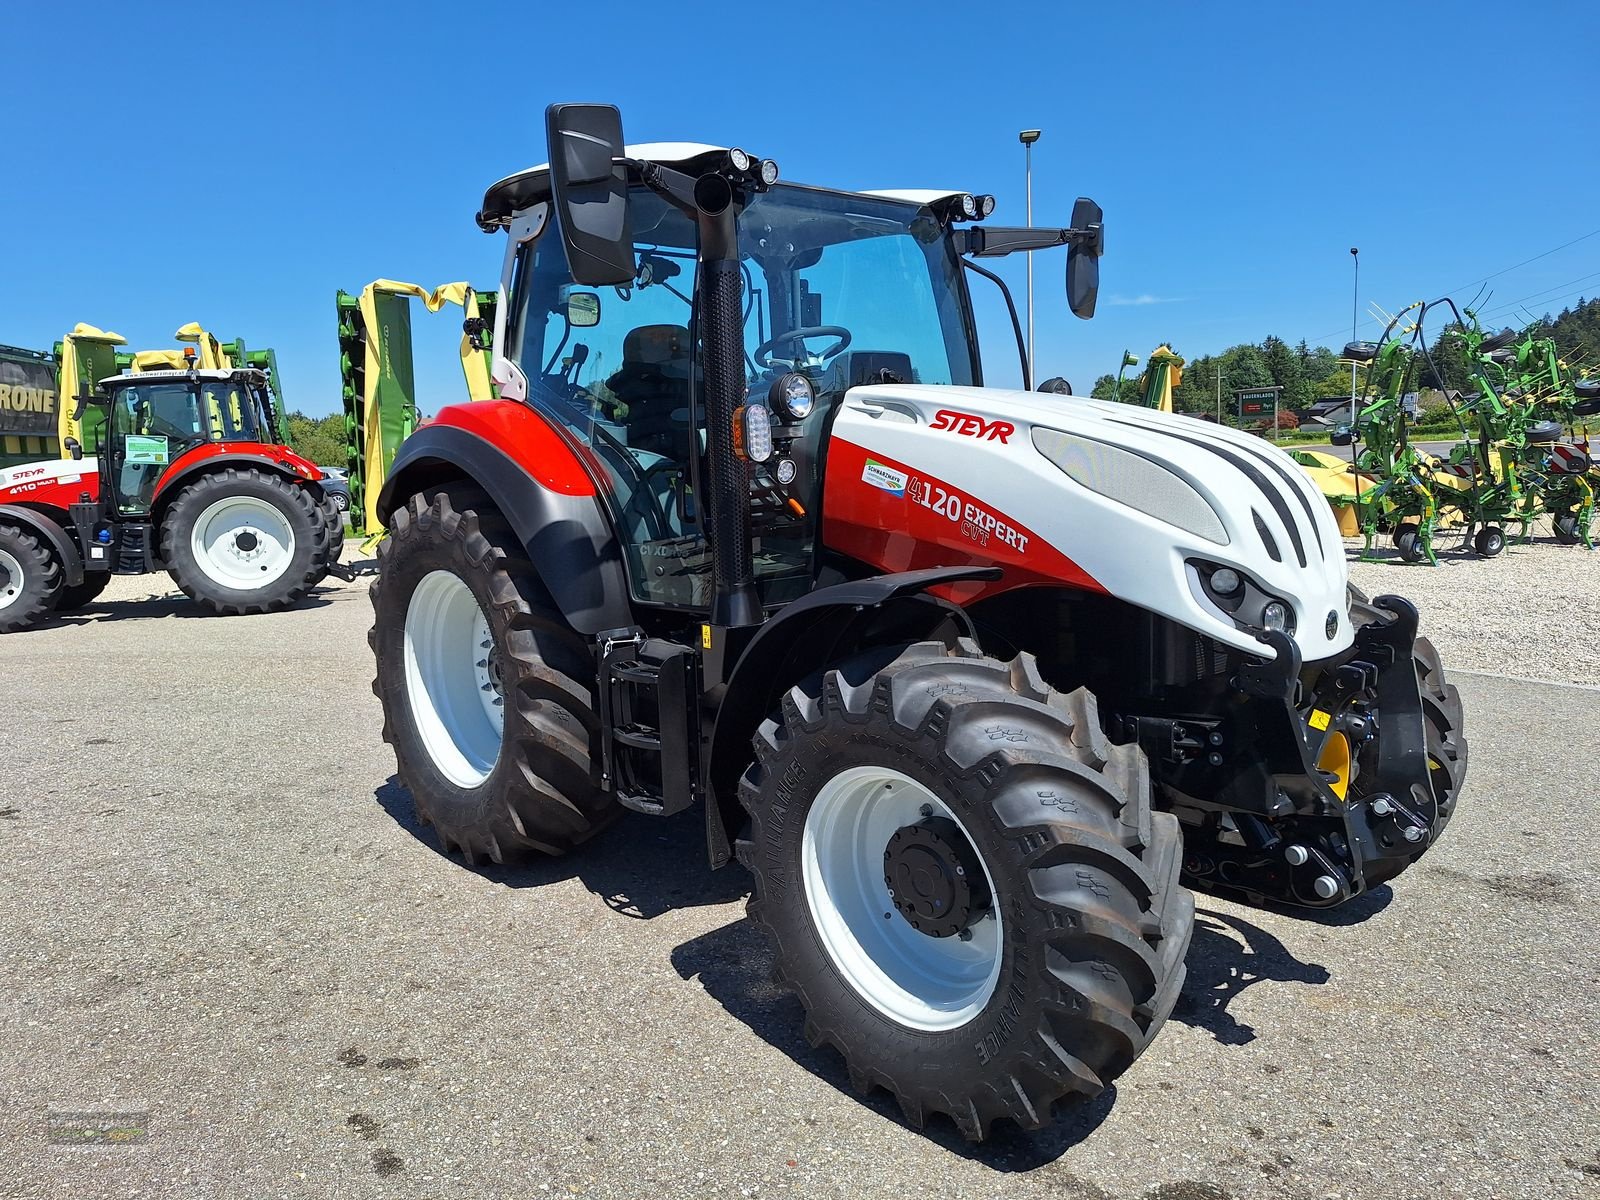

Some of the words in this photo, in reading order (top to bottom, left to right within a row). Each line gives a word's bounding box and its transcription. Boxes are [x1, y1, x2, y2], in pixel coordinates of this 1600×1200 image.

[929, 409, 1015, 444] STEYR
[12, 467, 45, 480] STEYR
[867, 465, 901, 483] SCHWARZMAYR
[9, 483, 37, 495] 4110
[36, 479, 56, 487] MULTI
[906, 476, 962, 523] 4120
[963, 503, 1029, 554] EXPERT
[960, 519, 990, 548] CVT
